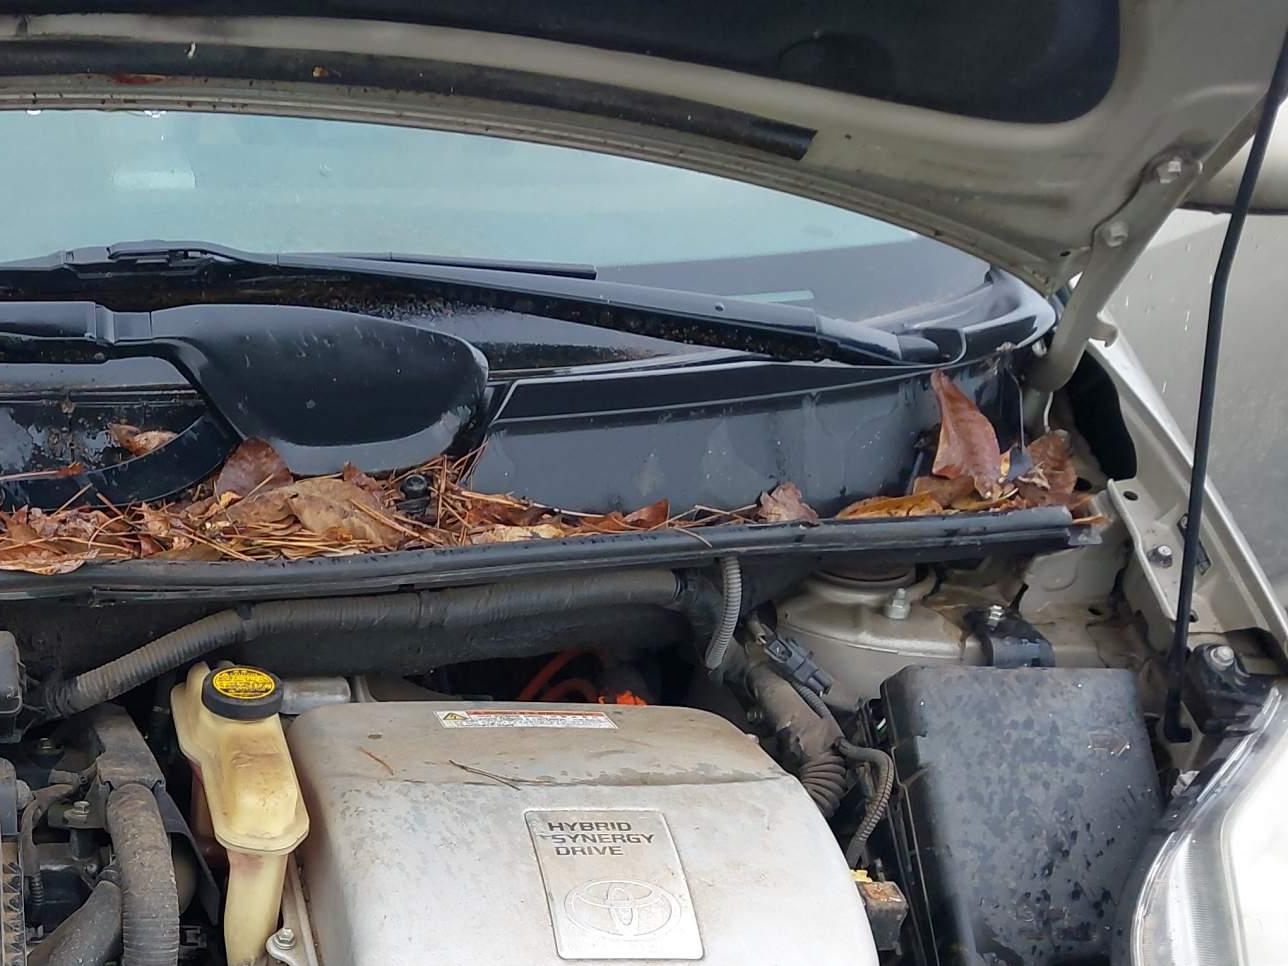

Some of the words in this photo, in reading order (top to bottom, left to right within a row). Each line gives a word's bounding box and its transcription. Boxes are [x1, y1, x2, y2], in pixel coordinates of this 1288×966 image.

[548, 822, 631, 832] HYBRID
[553, 833, 654, 844] SYNERGY
[556, 846, 624, 856] DRIVE
